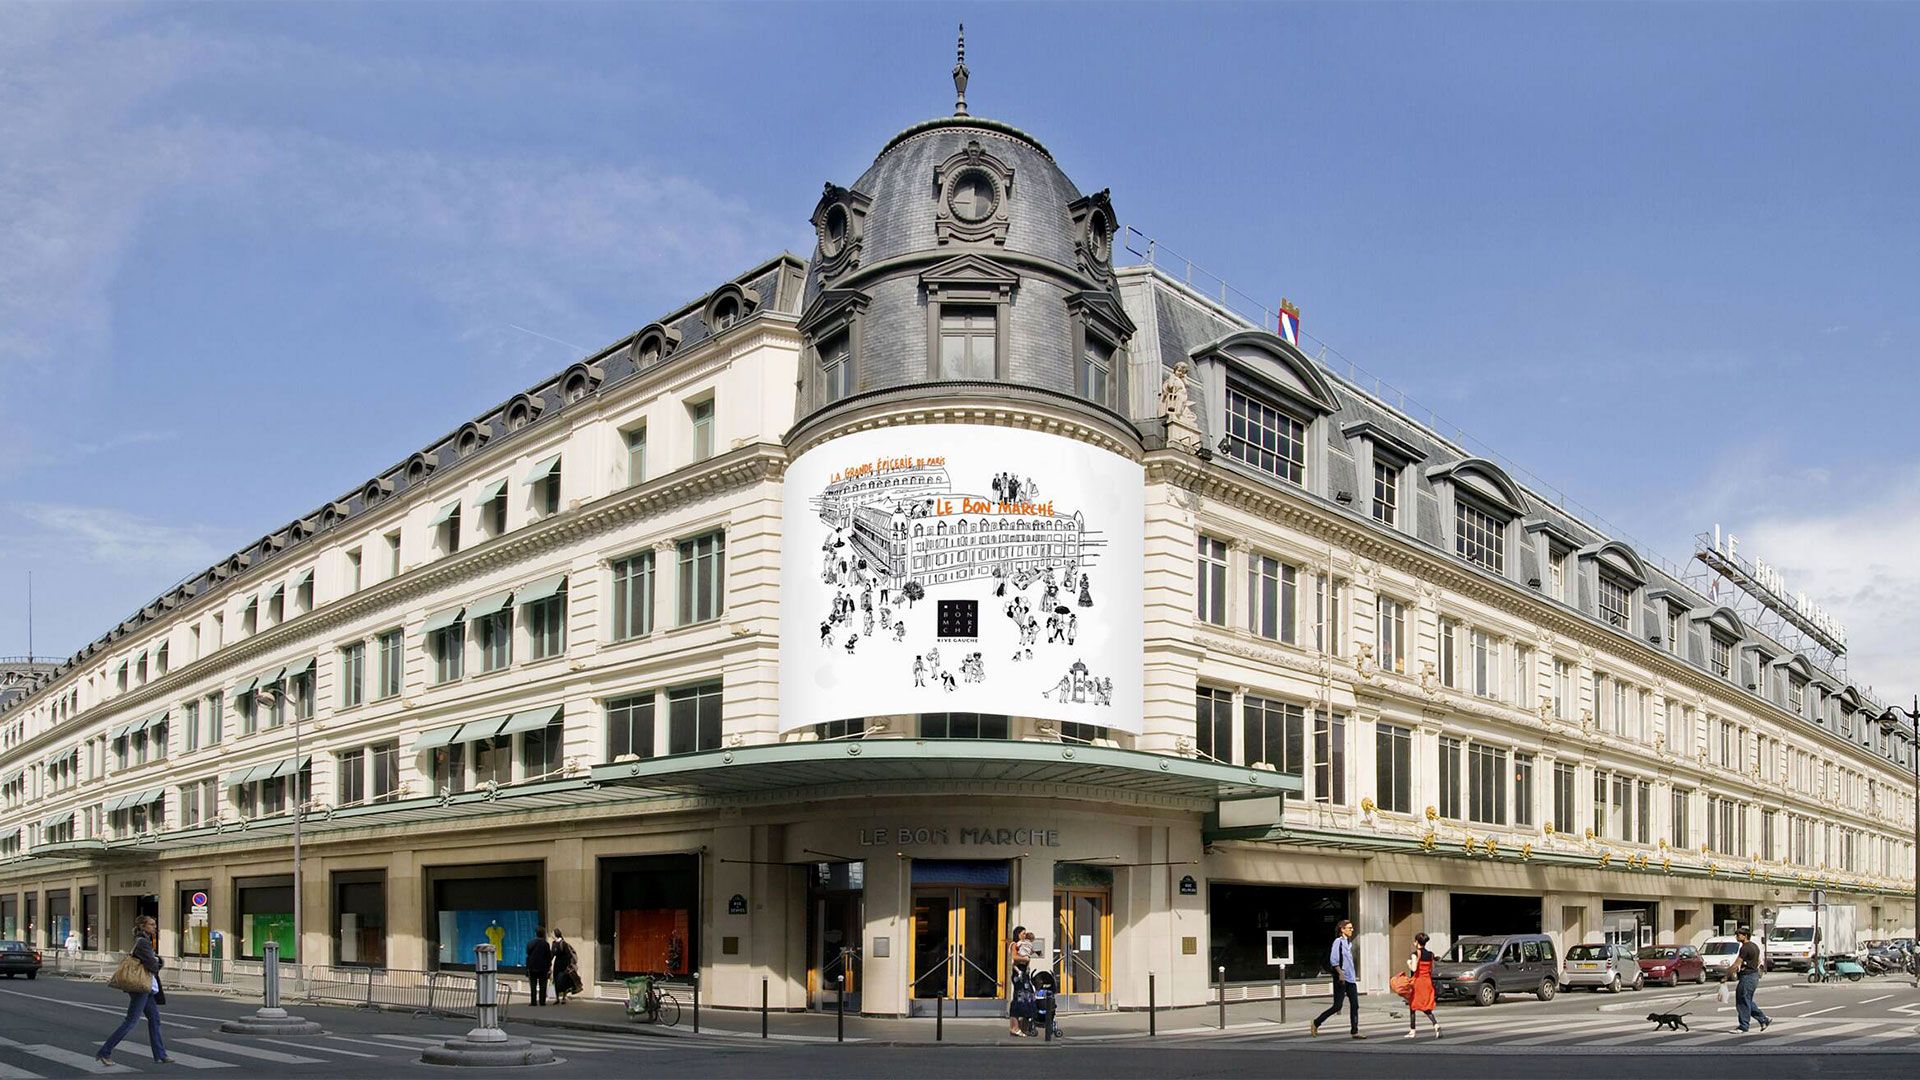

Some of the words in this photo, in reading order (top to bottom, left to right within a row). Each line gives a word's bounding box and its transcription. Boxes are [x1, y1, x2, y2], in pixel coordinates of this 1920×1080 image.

[830, 473, 841, 484] LA
[845, 463, 873, 479] GRANDE
[937, 498, 953, 517] LE
[963, 497, 991, 514] BON
[998, 500, 1055, 518] MARCHÉ
[1714, 523, 1740, 567] LE
[1755, 556, 1785, 600] BON
[859, 828, 888, 846] LE
[896, 828, 950, 845] BON
[959, 827, 1061, 847] MARCHE
